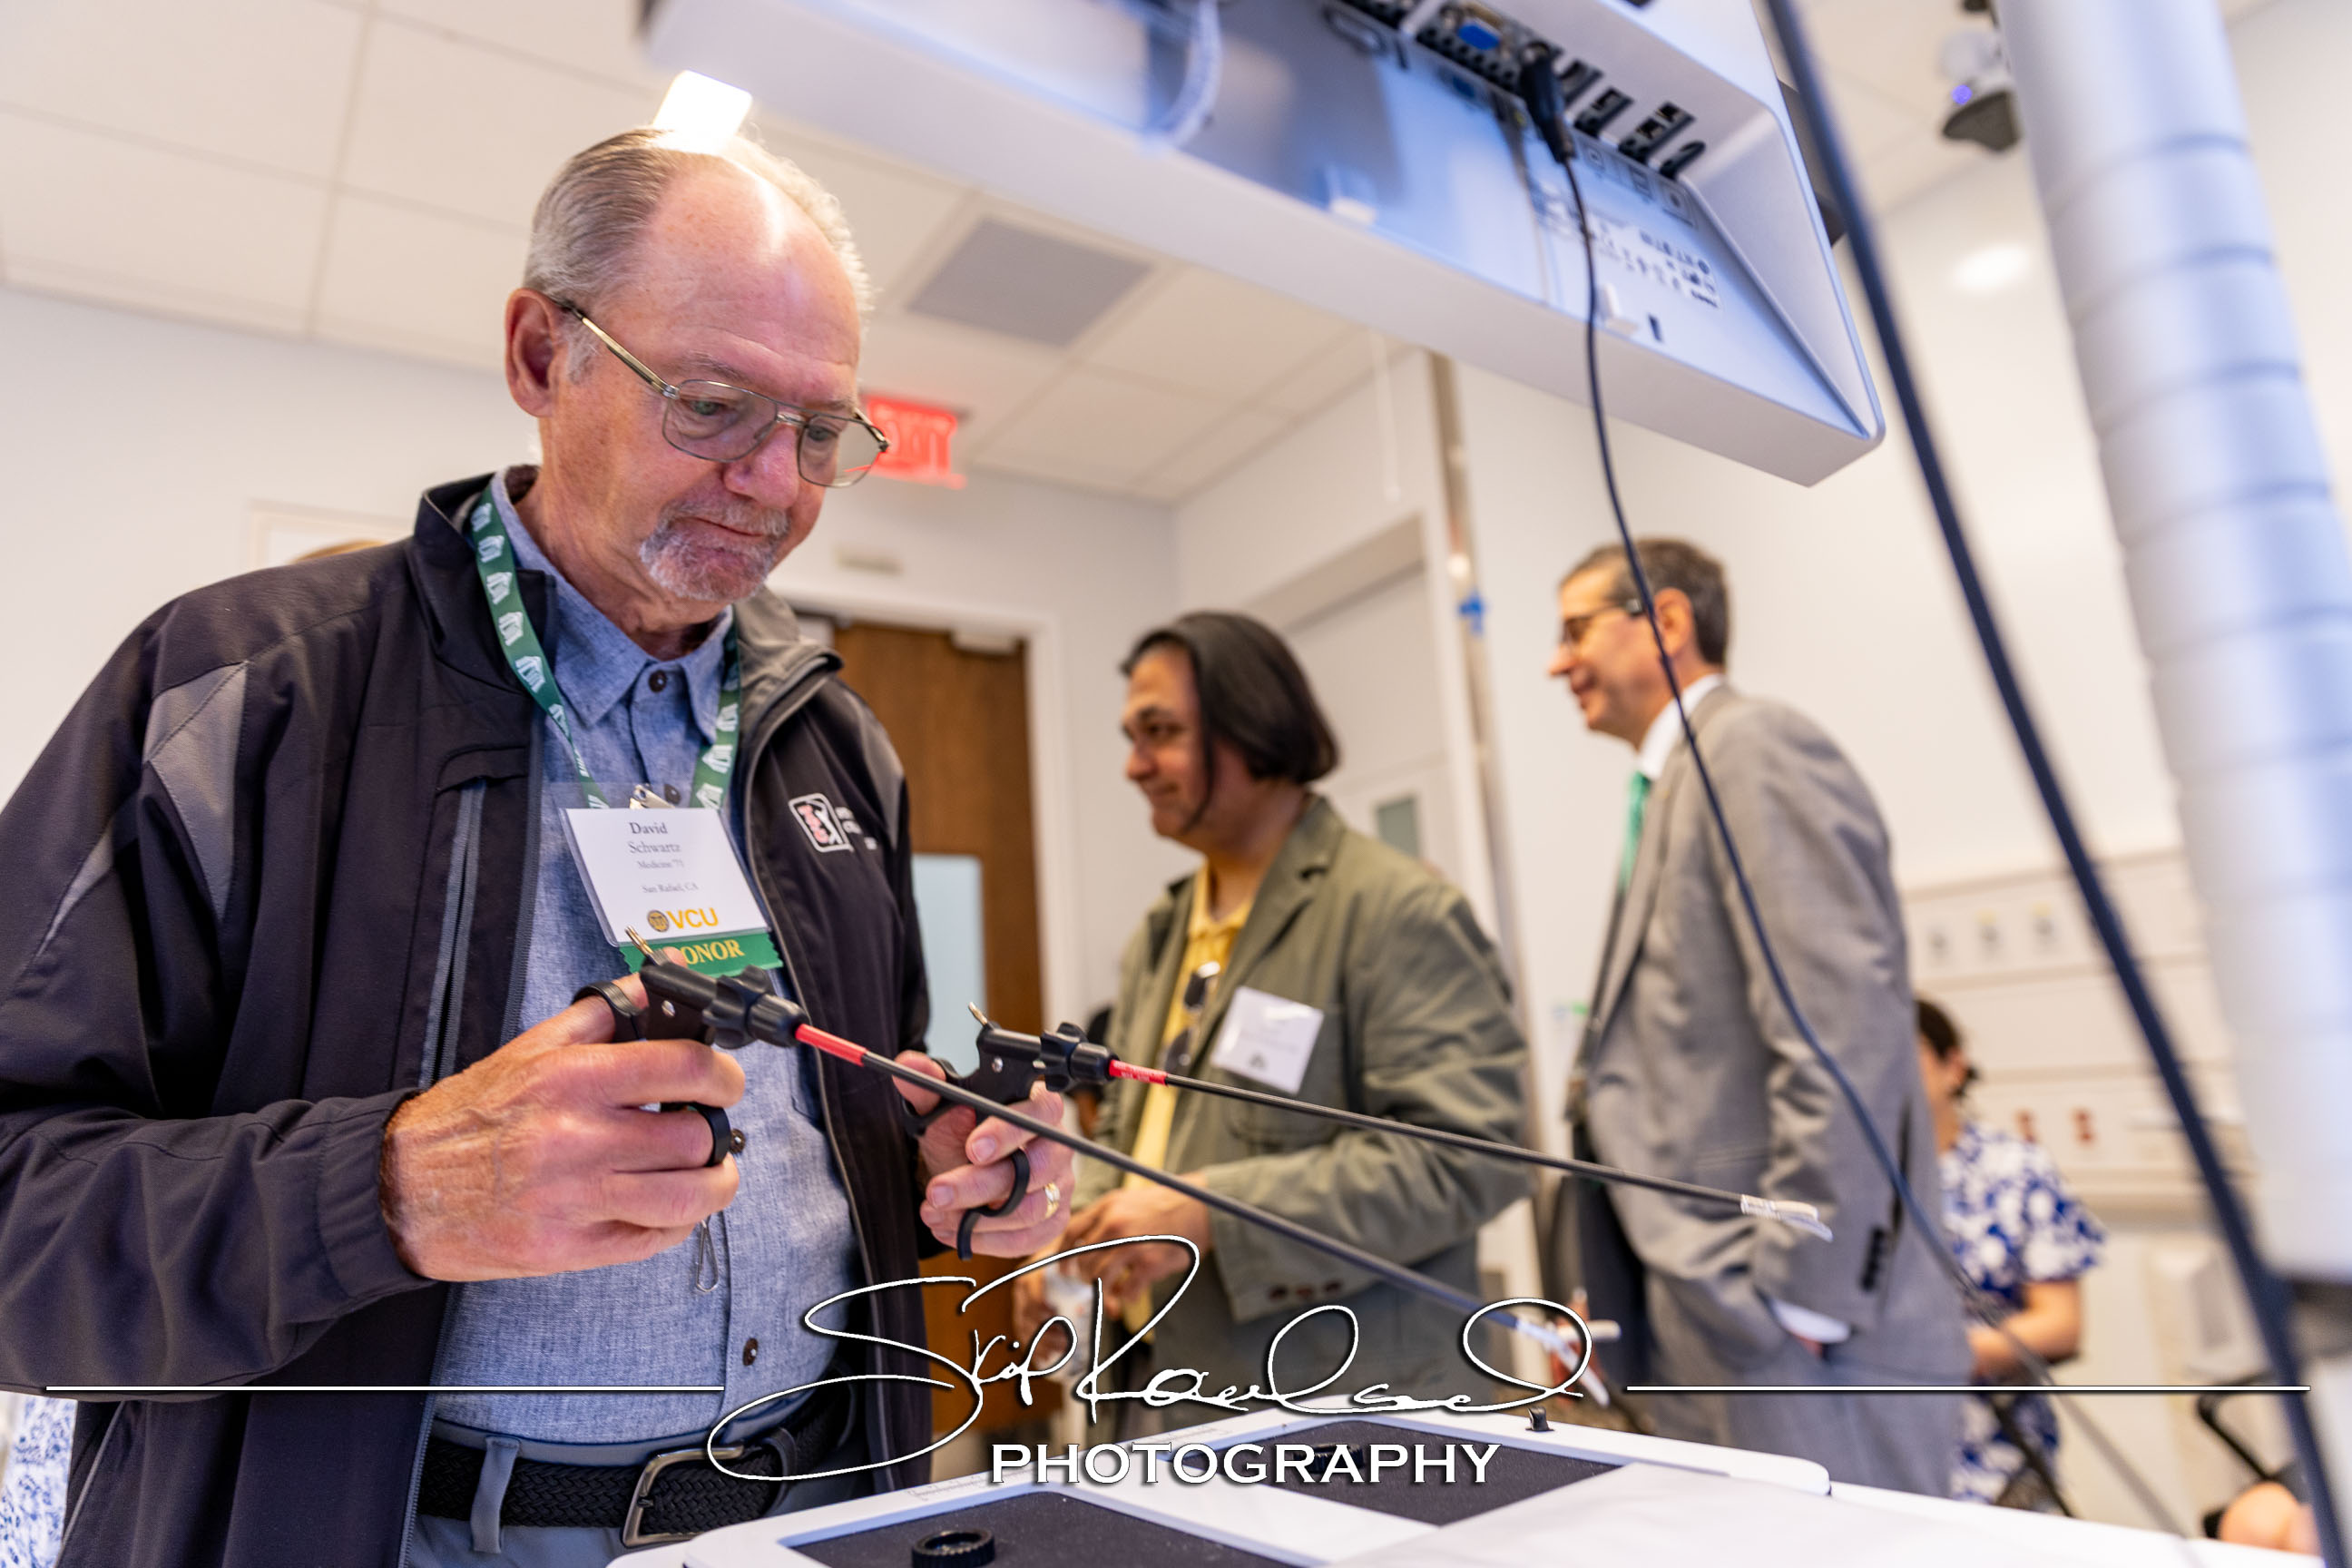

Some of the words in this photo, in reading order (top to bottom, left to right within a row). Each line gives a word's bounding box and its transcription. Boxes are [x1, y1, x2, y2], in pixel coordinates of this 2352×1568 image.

[629, 821, 669, 835] David
[627, 839, 681, 854] Schwartz
[666, 907, 720, 929] VCU
[680, 939, 745, 965] ONOR
